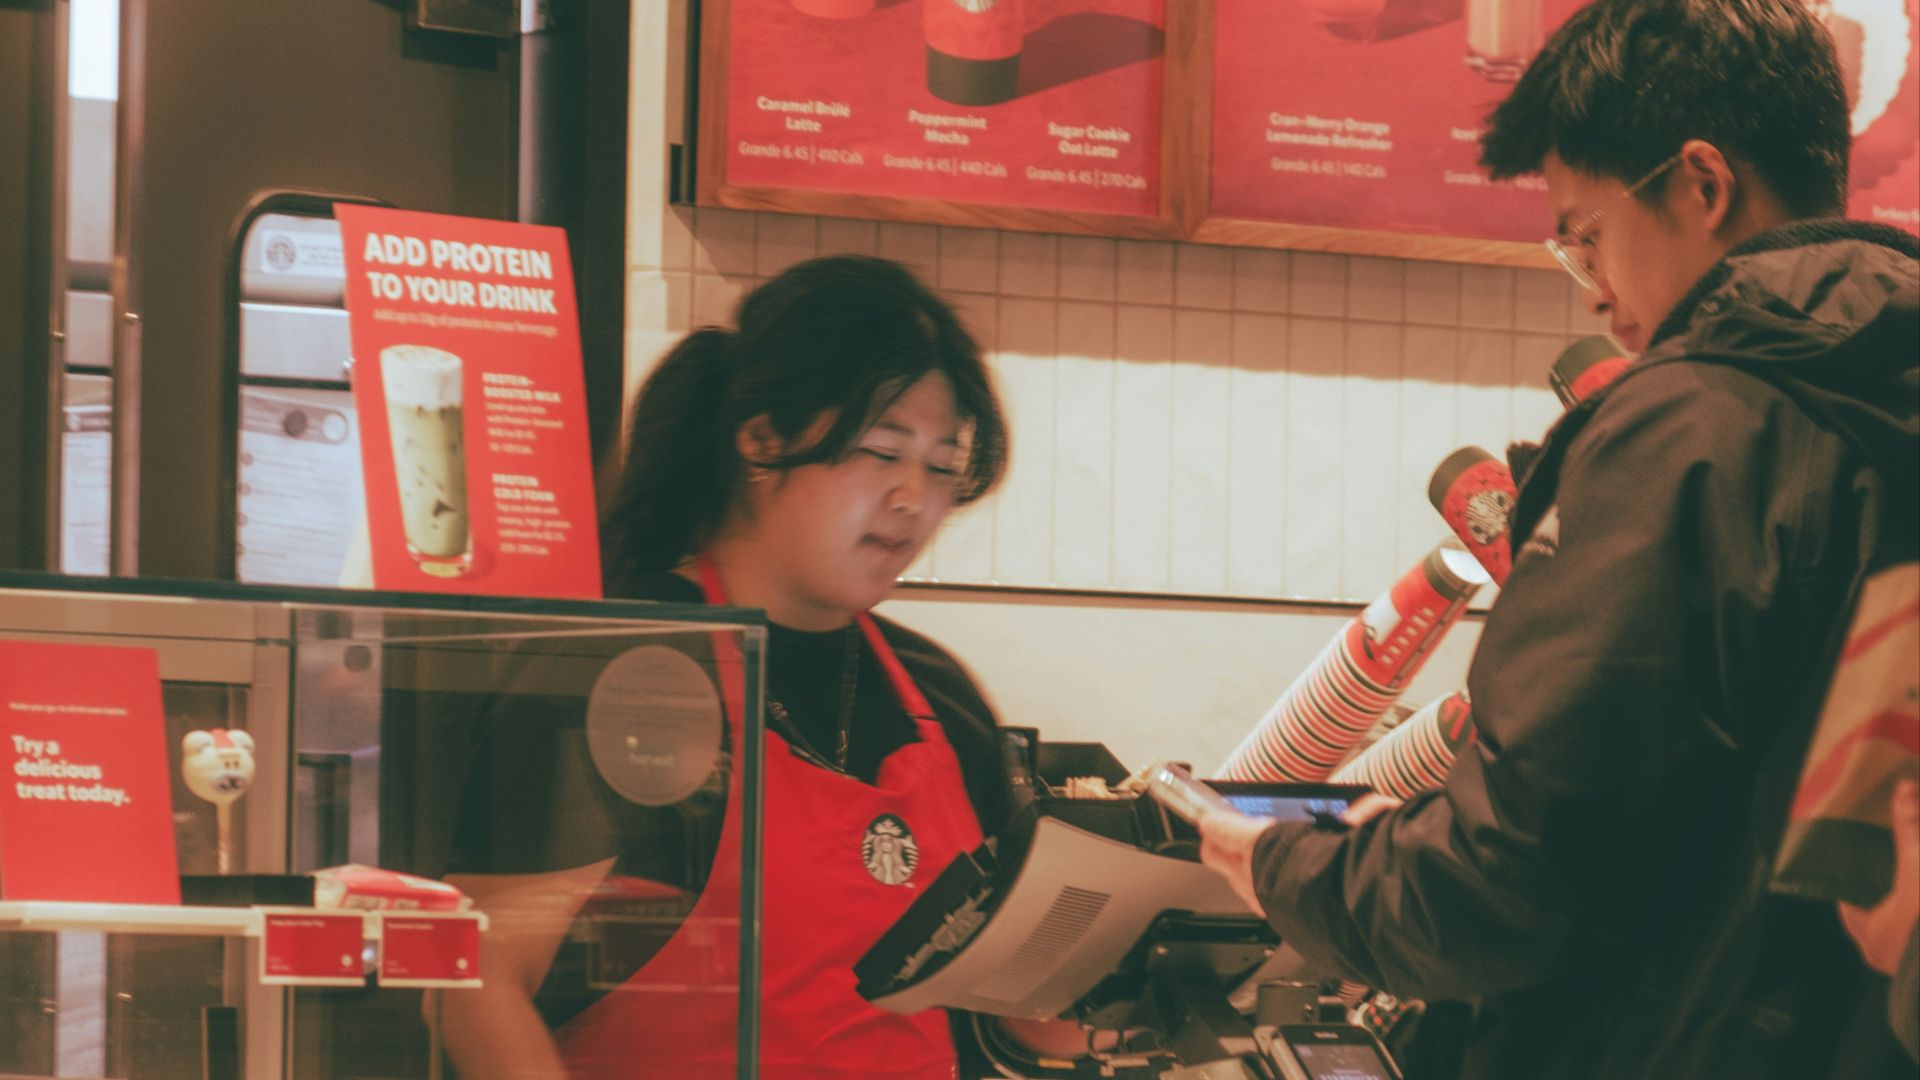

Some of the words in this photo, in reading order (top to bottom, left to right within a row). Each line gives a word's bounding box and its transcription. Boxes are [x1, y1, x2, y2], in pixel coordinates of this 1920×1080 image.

[756, 95, 813, 113] Caramel
[785, 115, 821, 132] Latte
[908, 108, 987, 129] Peppermint
[1344, 117, 1389, 135] Orange
[923, 127, 969, 145] Mocha
[1047, 121, 1084, 138] Sugar
[1086, 124, 1130, 142] Cookie
[1266, 128, 1329, 145] Lemonade
[1332, 133, 1392, 150] Refresher
[738, 140, 780, 157] Grande
[782, 143, 808, 159] 6.45
[840, 149, 863, 164] Cals
[1058, 140, 1082, 155] Oat
[1084, 142, 1118, 158] Latte
[882, 152, 924, 169] Grande
[983, 160, 1007, 177] Cals
[1025, 165, 1066, 181] Grande
[1270, 156, 1309, 171] Grande
[364, 232, 426, 266] ADD
[431, 239, 552, 279] PROTEIN
[367, 271, 402, 299] TO
[405, 275, 475, 306] YOUR
[480, 283, 557, 314] DRINK
[11, 735, 42, 757] Try
[45, 740, 59, 754] a
[14, 757, 102, 779] delicious
[16, 782, 65, 800] treat
[67, 783, 131, 806] today.
